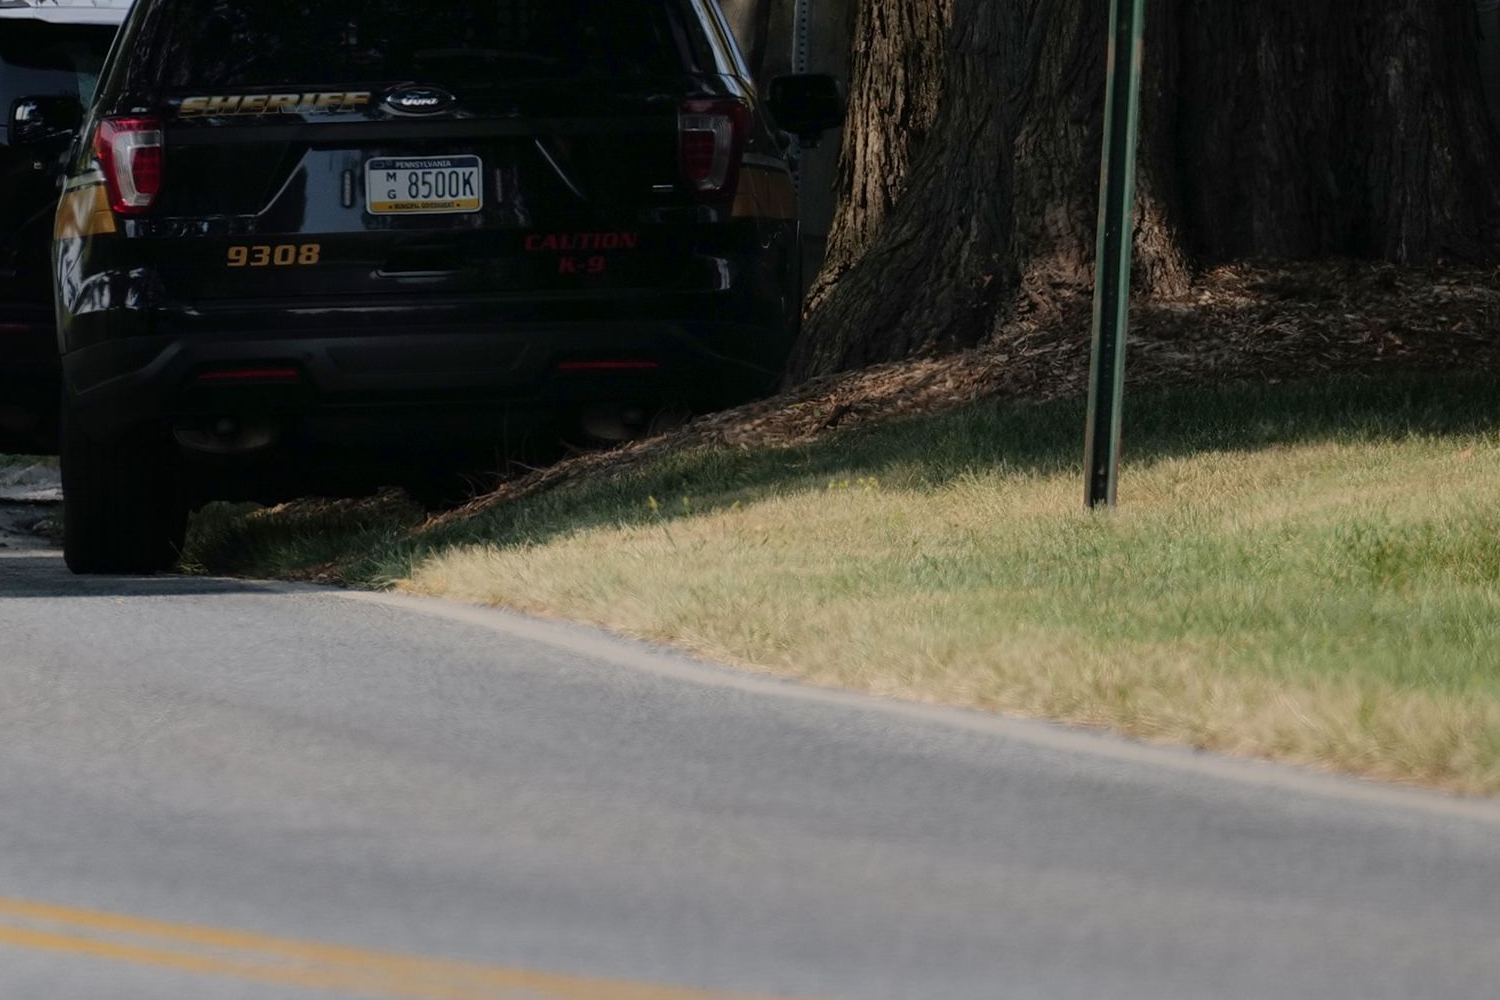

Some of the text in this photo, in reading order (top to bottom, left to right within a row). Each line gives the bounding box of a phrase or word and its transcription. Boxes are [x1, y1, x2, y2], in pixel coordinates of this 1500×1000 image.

[179, 91, 372, 119] SHERIFF
[395, 159, 452, 169] PENNSYLVANIA
[386, 172, 397, 182] M
[408, 171, 474, 198] 8500K
[524, 231, 639, 252] CAUTION
[227, 242, 321, 268] 9308
[557, 255, 607, 275] K-9
